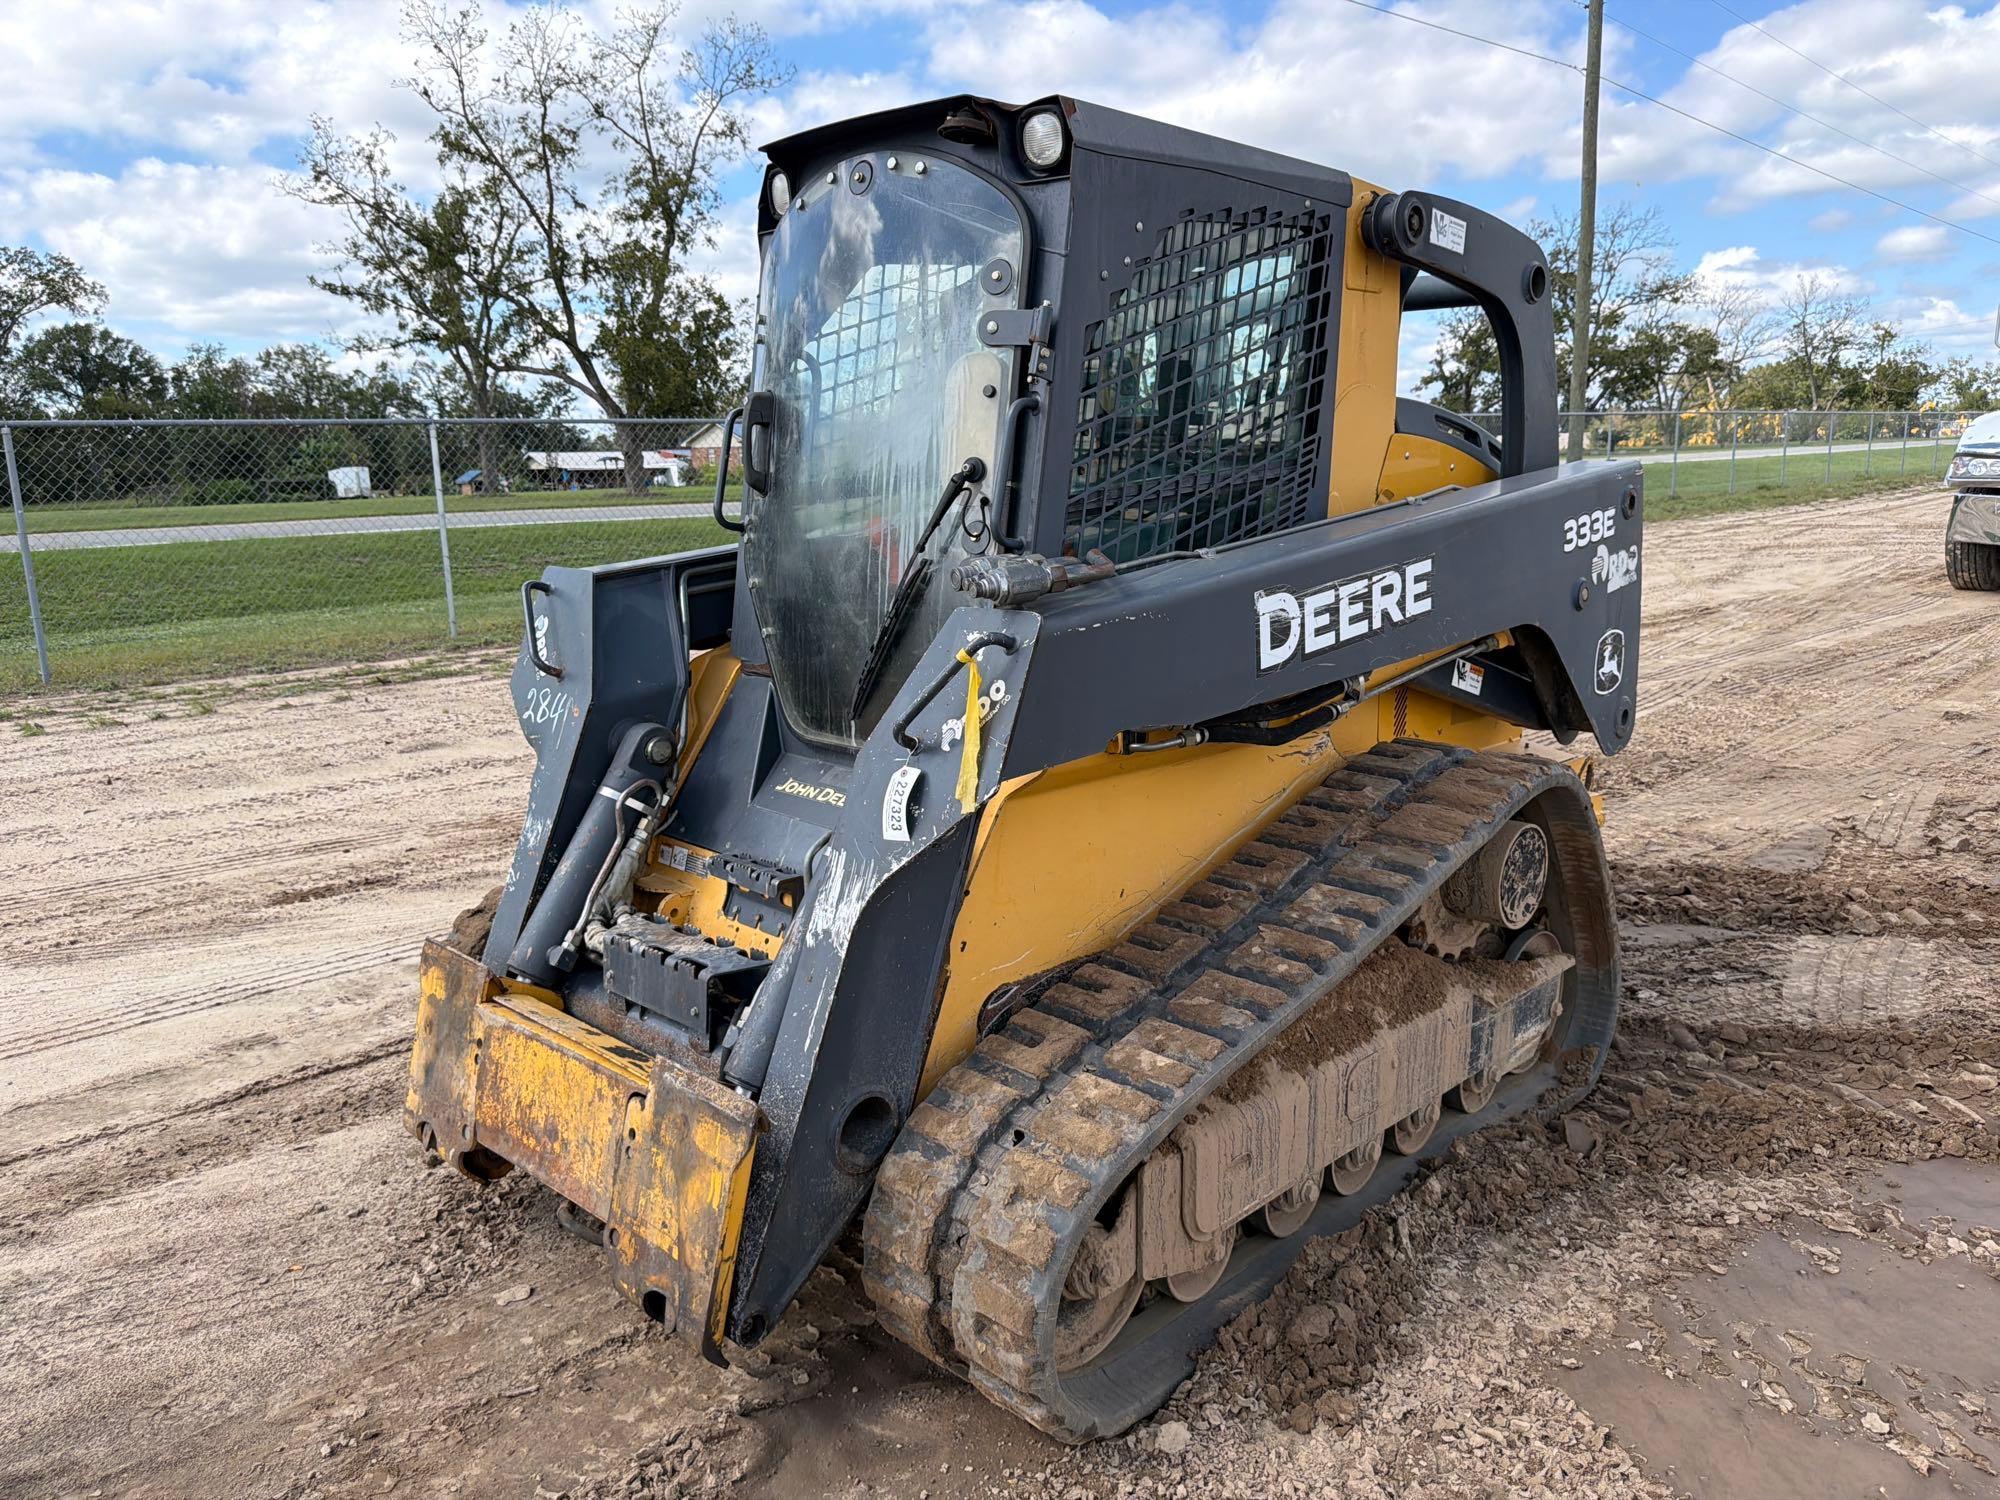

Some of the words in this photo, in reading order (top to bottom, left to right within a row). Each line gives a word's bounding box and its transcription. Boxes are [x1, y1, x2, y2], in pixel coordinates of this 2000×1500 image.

[1564, 506, 1616, 553] 333E
[1256, 559, 1432, 670] DEERE
[775, 777, 820, 799] JOHN
[891, 781, 908, 831] 227323
